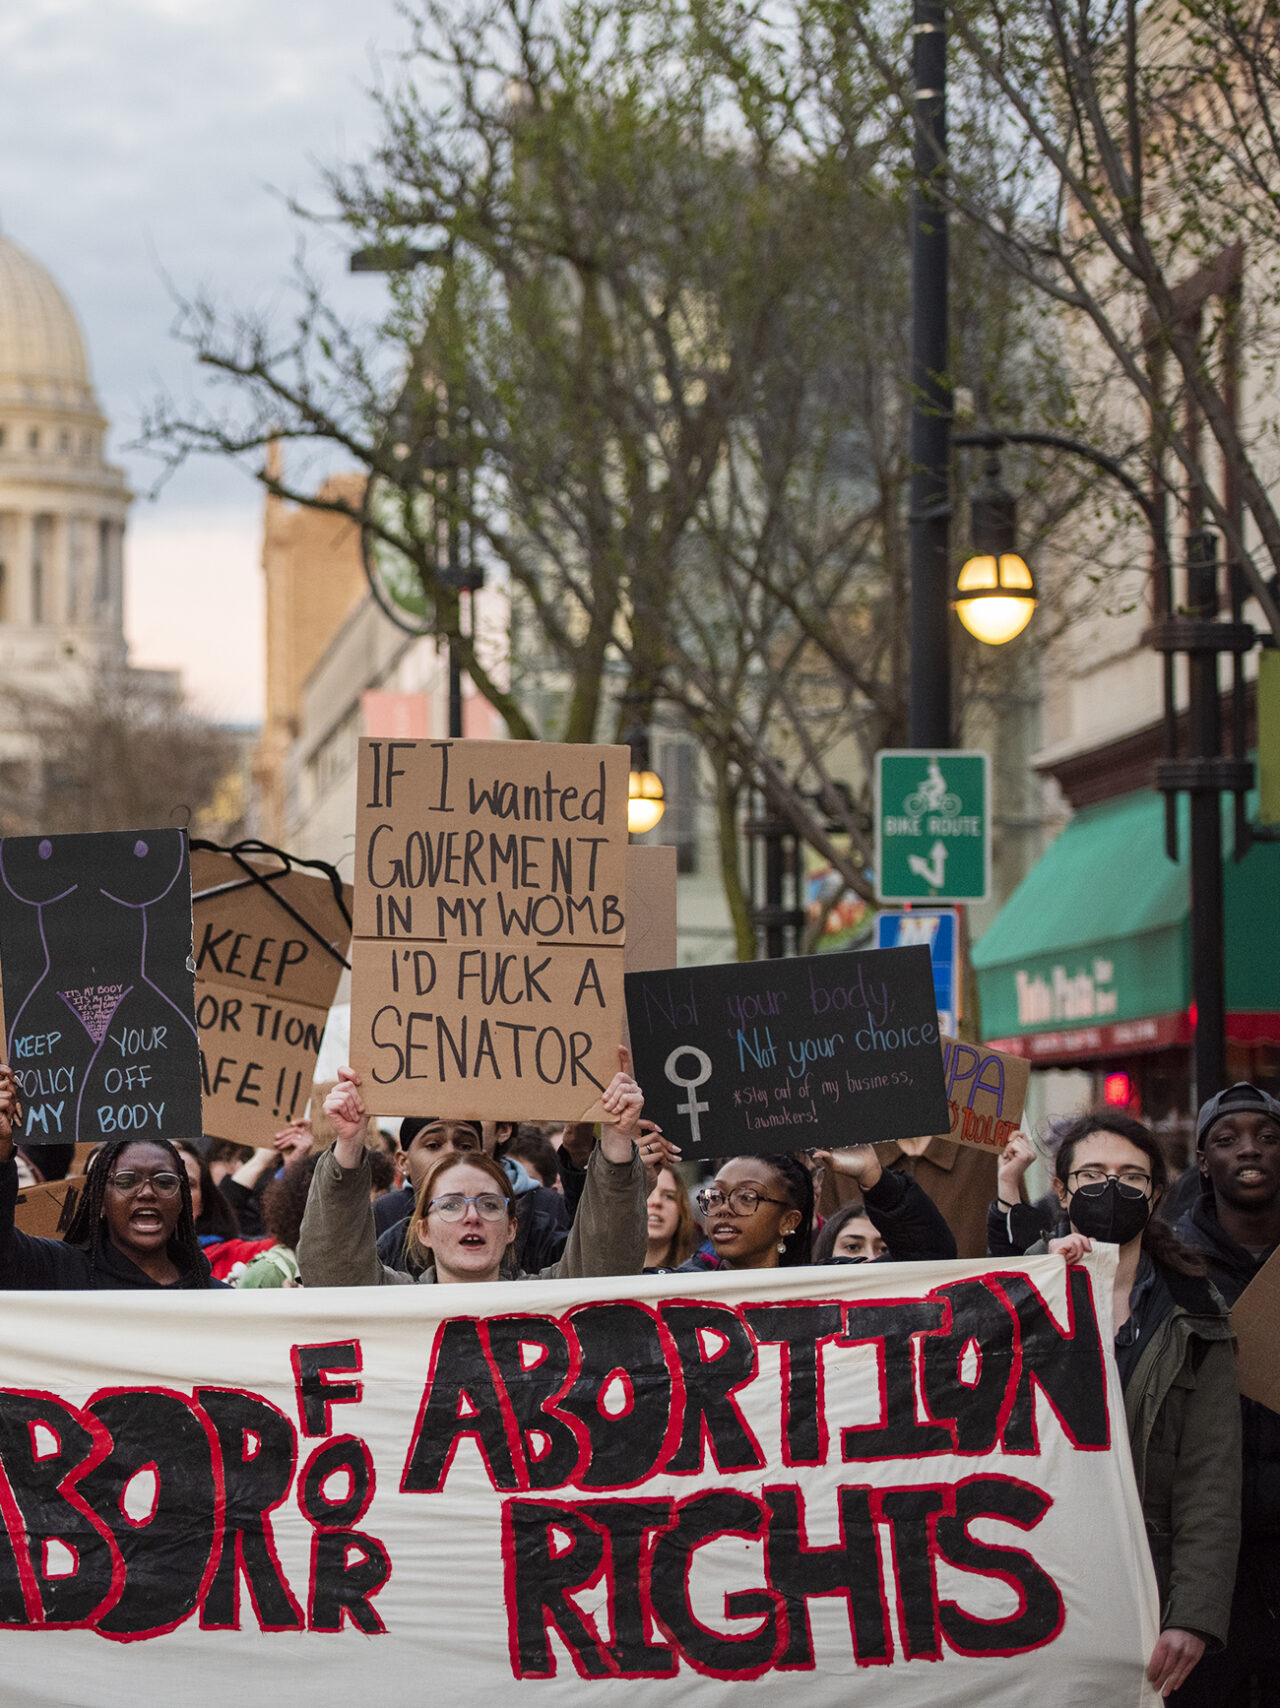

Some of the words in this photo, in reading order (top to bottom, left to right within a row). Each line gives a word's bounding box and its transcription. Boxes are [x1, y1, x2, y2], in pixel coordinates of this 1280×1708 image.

[365, 742, 417, 809] IF
[428, 742, 454, 812] I
[468, 761, 607, 825] wanted
[884, 816, 922, 837] BIKE
[927, 815, 982, 837] ROUTE
[367, 824, 610, 893] GOVERMENT
[376, 892, 412, 938] IN
[437, 896, 486, 938] MY
[496, 891, 625, 938] WOMB
[195, 922, 311, 988] KEEP
[390, 949, 437, 996] I'D
[457, 949, 553, 1005] FUCK
[573, 957, 607, 1009] A
[97, 984, 123, 995] BODY
[727, 988, 789, 1039] your
[14, 1031, 62, 1060] KEEP
[109, 1026, 168, 1057] YOUR
[196, 993, 326, 1055] ORTION
[371, 1004, 608, 1093] SENATOR
[736, 1025, 778, 1073] Not
[788, 1033, 845, 1079] your
[855, 1011, 939, 1051] choice
[104, 1065, 153, 1094] OFF
[774, 1077, 792, 1100] out
[798, 1072, 813, 1098] of
[821, 1081, 841, 1105] my
[25, 1100, 65, 1137] MY
[97, 1102, 166, 1134] BODY
[745, 1100, 820, 1131] Lawmakers!
[291, 1338, 393, 1636] FOR
[399, 1265, 1111, 1495] ABORTION
[500, 1472, 1067, 1682] RIGHTS
